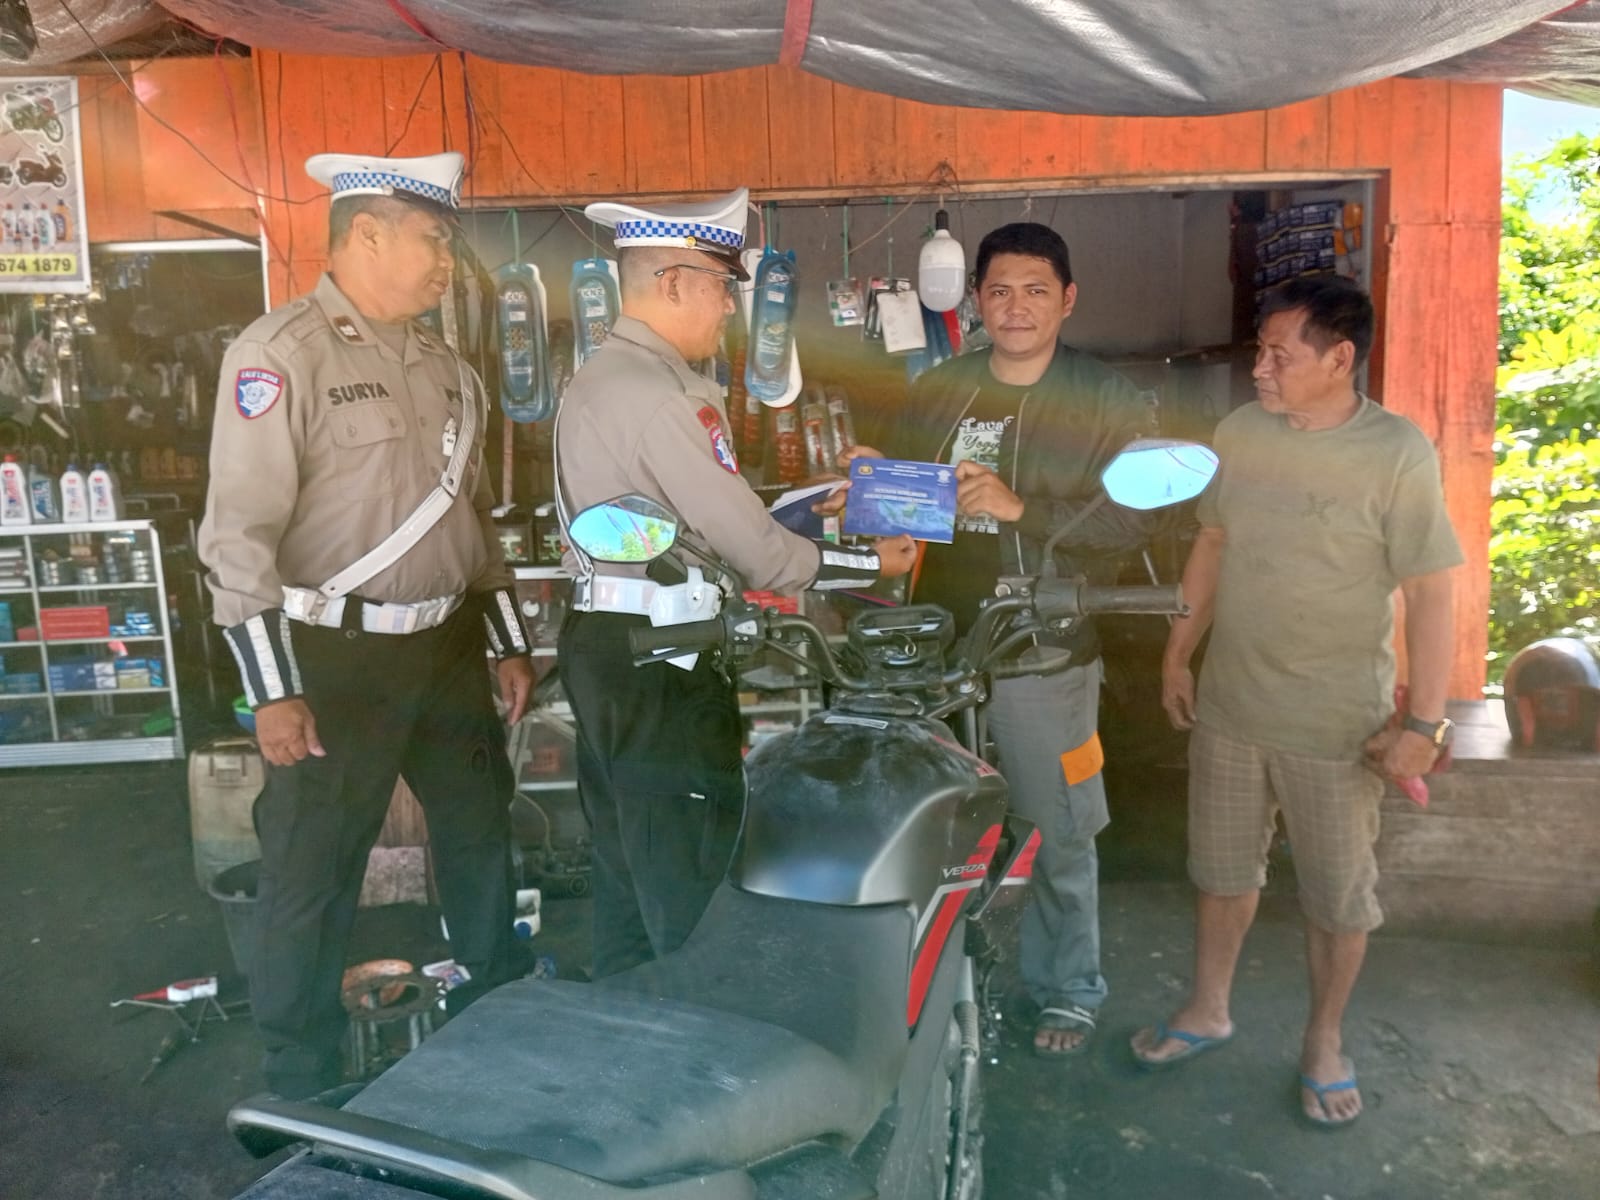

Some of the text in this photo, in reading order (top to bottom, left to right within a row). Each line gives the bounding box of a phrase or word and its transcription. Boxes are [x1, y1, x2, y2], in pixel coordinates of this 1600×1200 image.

[33, 258, 71, 272] 1879
[328, 382, 390, 406] SURYA
[942, 863, 987, 879] VERZA
